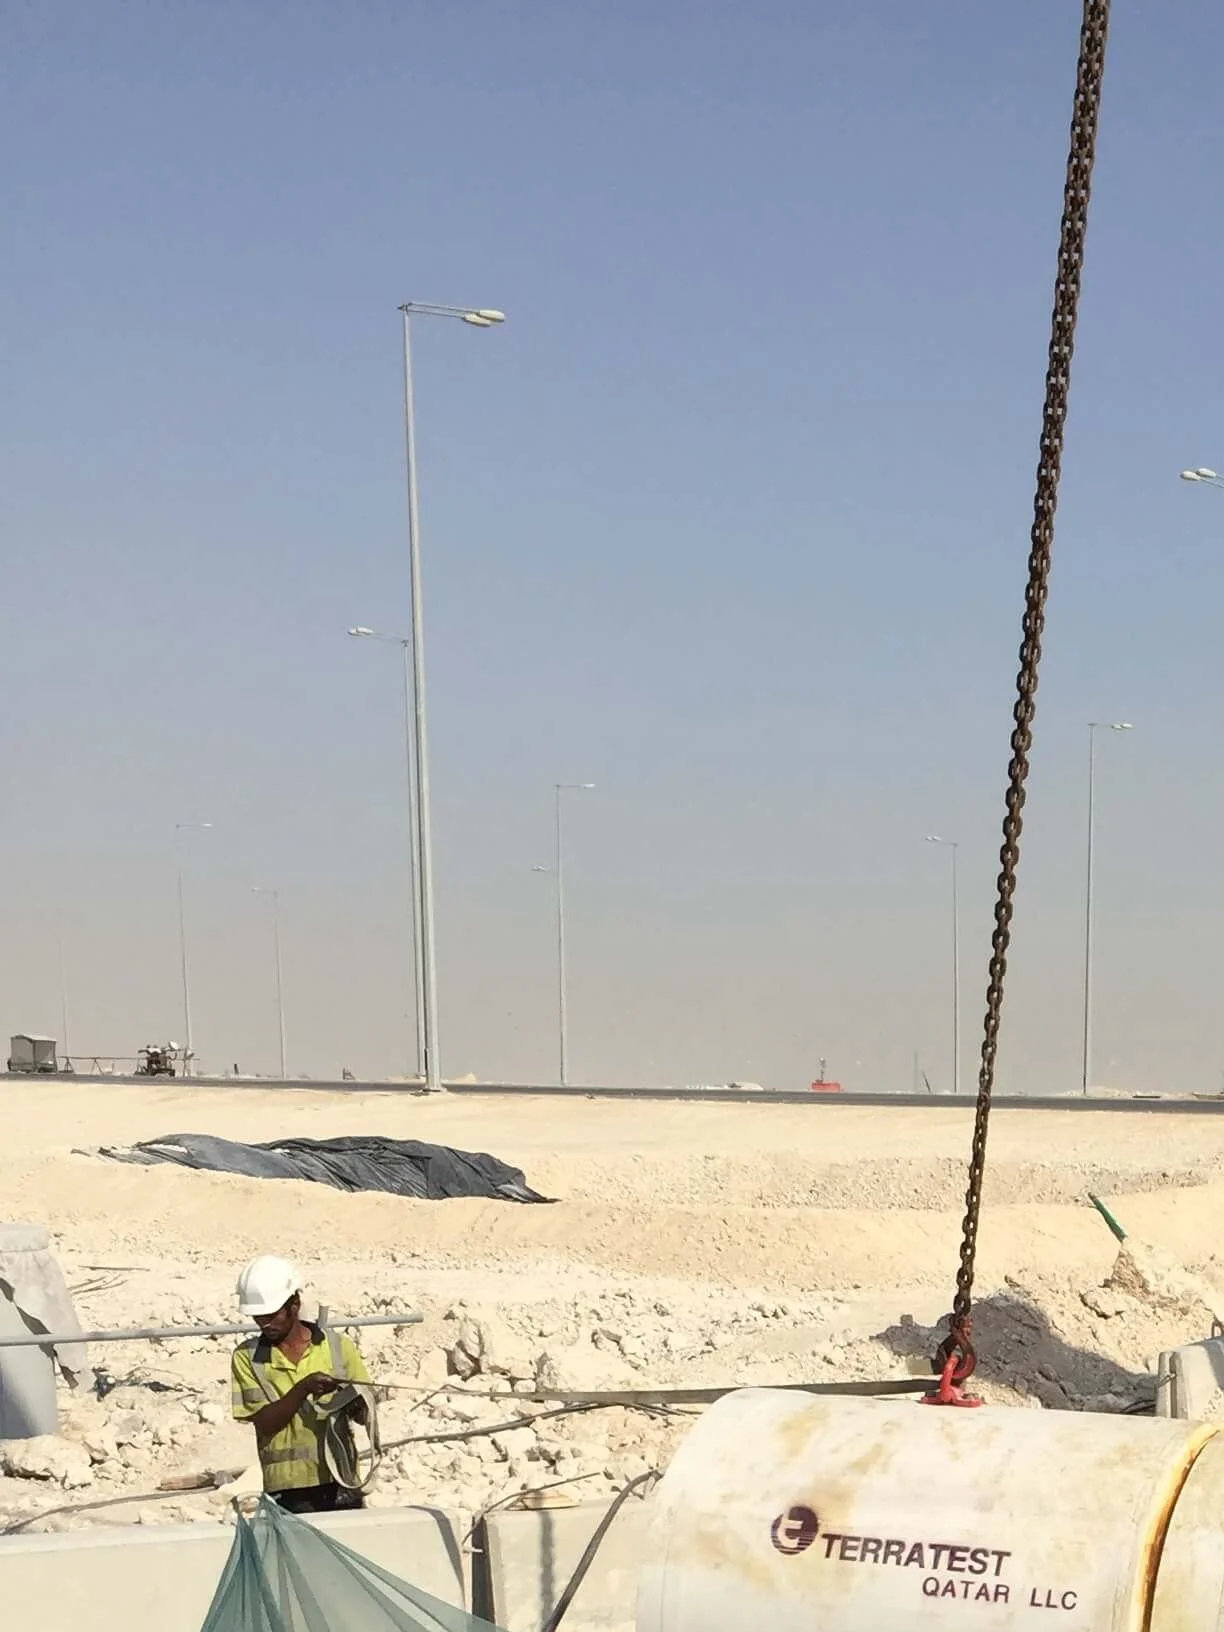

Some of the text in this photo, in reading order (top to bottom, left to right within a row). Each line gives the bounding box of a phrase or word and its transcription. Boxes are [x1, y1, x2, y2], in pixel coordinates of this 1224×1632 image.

[821, 1533, 1012, 1577] TERRATEST
[922, 1576, 1078, 1610] QATAR LLC
